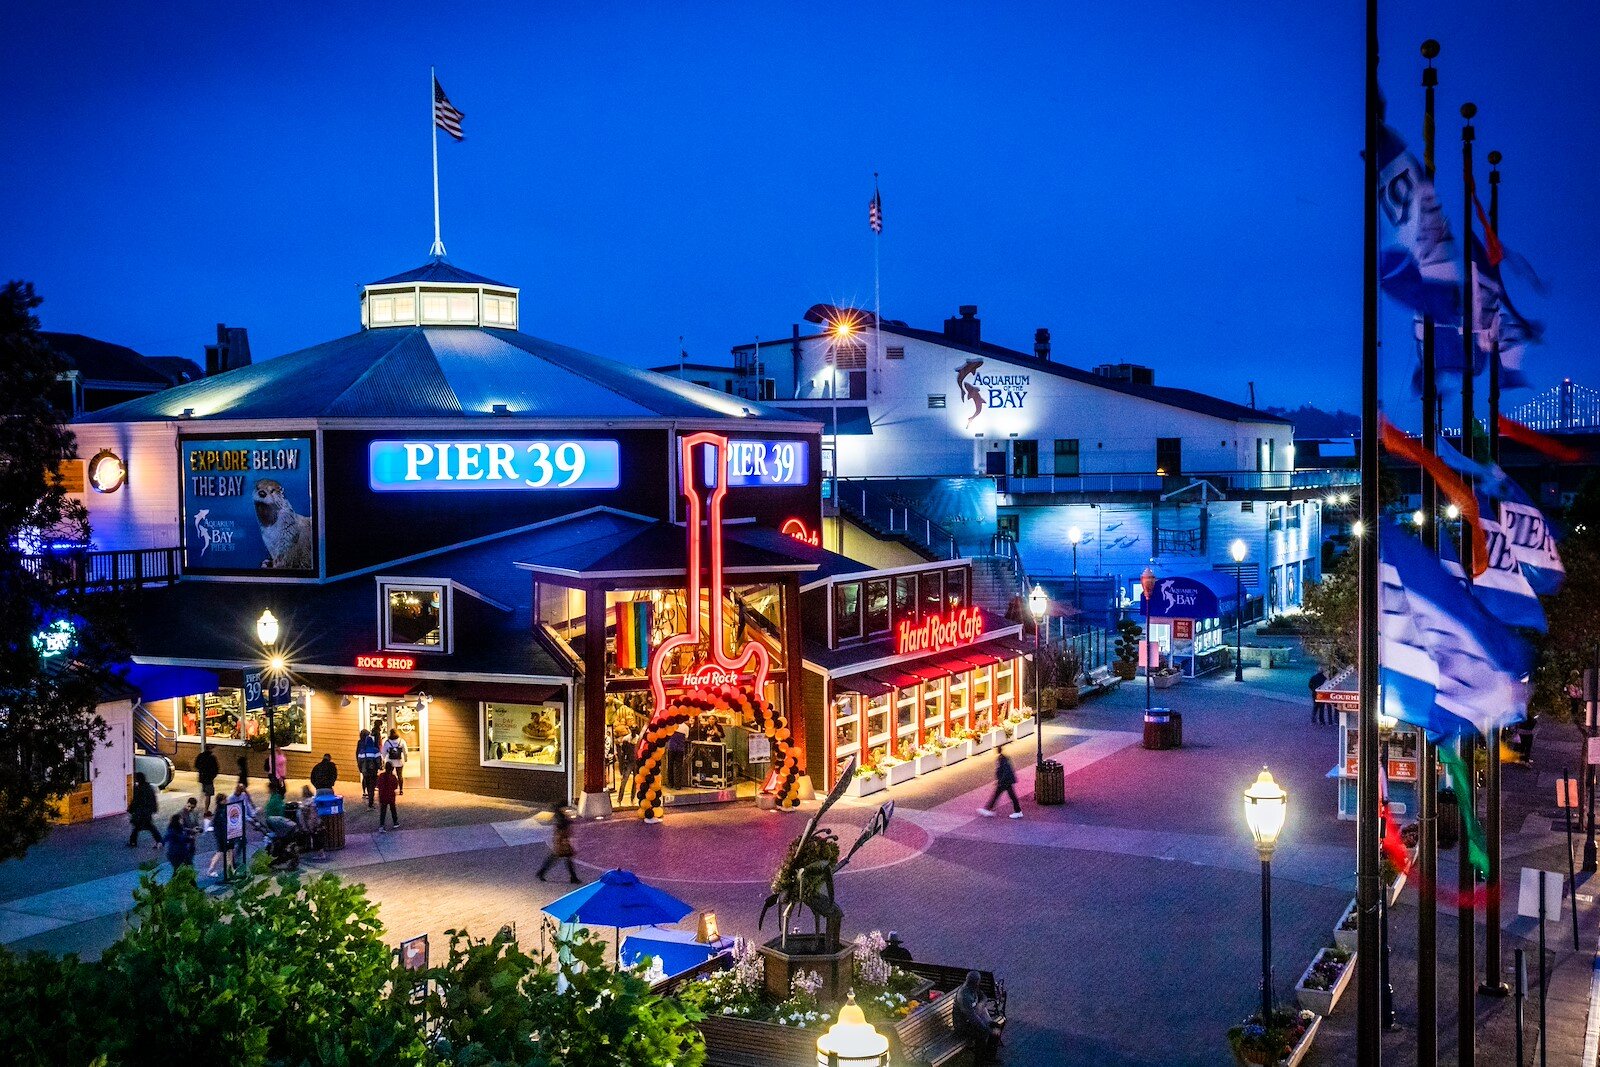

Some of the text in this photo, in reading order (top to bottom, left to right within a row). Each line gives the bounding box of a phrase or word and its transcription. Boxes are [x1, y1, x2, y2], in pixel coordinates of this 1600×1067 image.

[973, 372, 1029, 388] AQUARIUM
[988, 389, 1027, 408] BAY
[190, 449, 298, 471] EXPLORE BELOW
[403, 442, 586, 487] PIER 39
[771, 443, 795, 482] 39
[192, 476, 243, 496] THE BAY
[204, 518, 235, 529] AQUARIUM
[212, 529, 234, 543] BAY
[1169, 586, 1198, 594] AQUARIUM
[1176, 594, 1196, 606] BAY
[899, 607, 982, 655] Hard Rock Cafe
[357, 656, 413, 669] ROCK SHOP
[246, 673, 261, 682] PIER
[682, 670, 738, 686] Hard Rock
[246, 682, 261, 702] 39
[272, 677, 290, 697] 39
